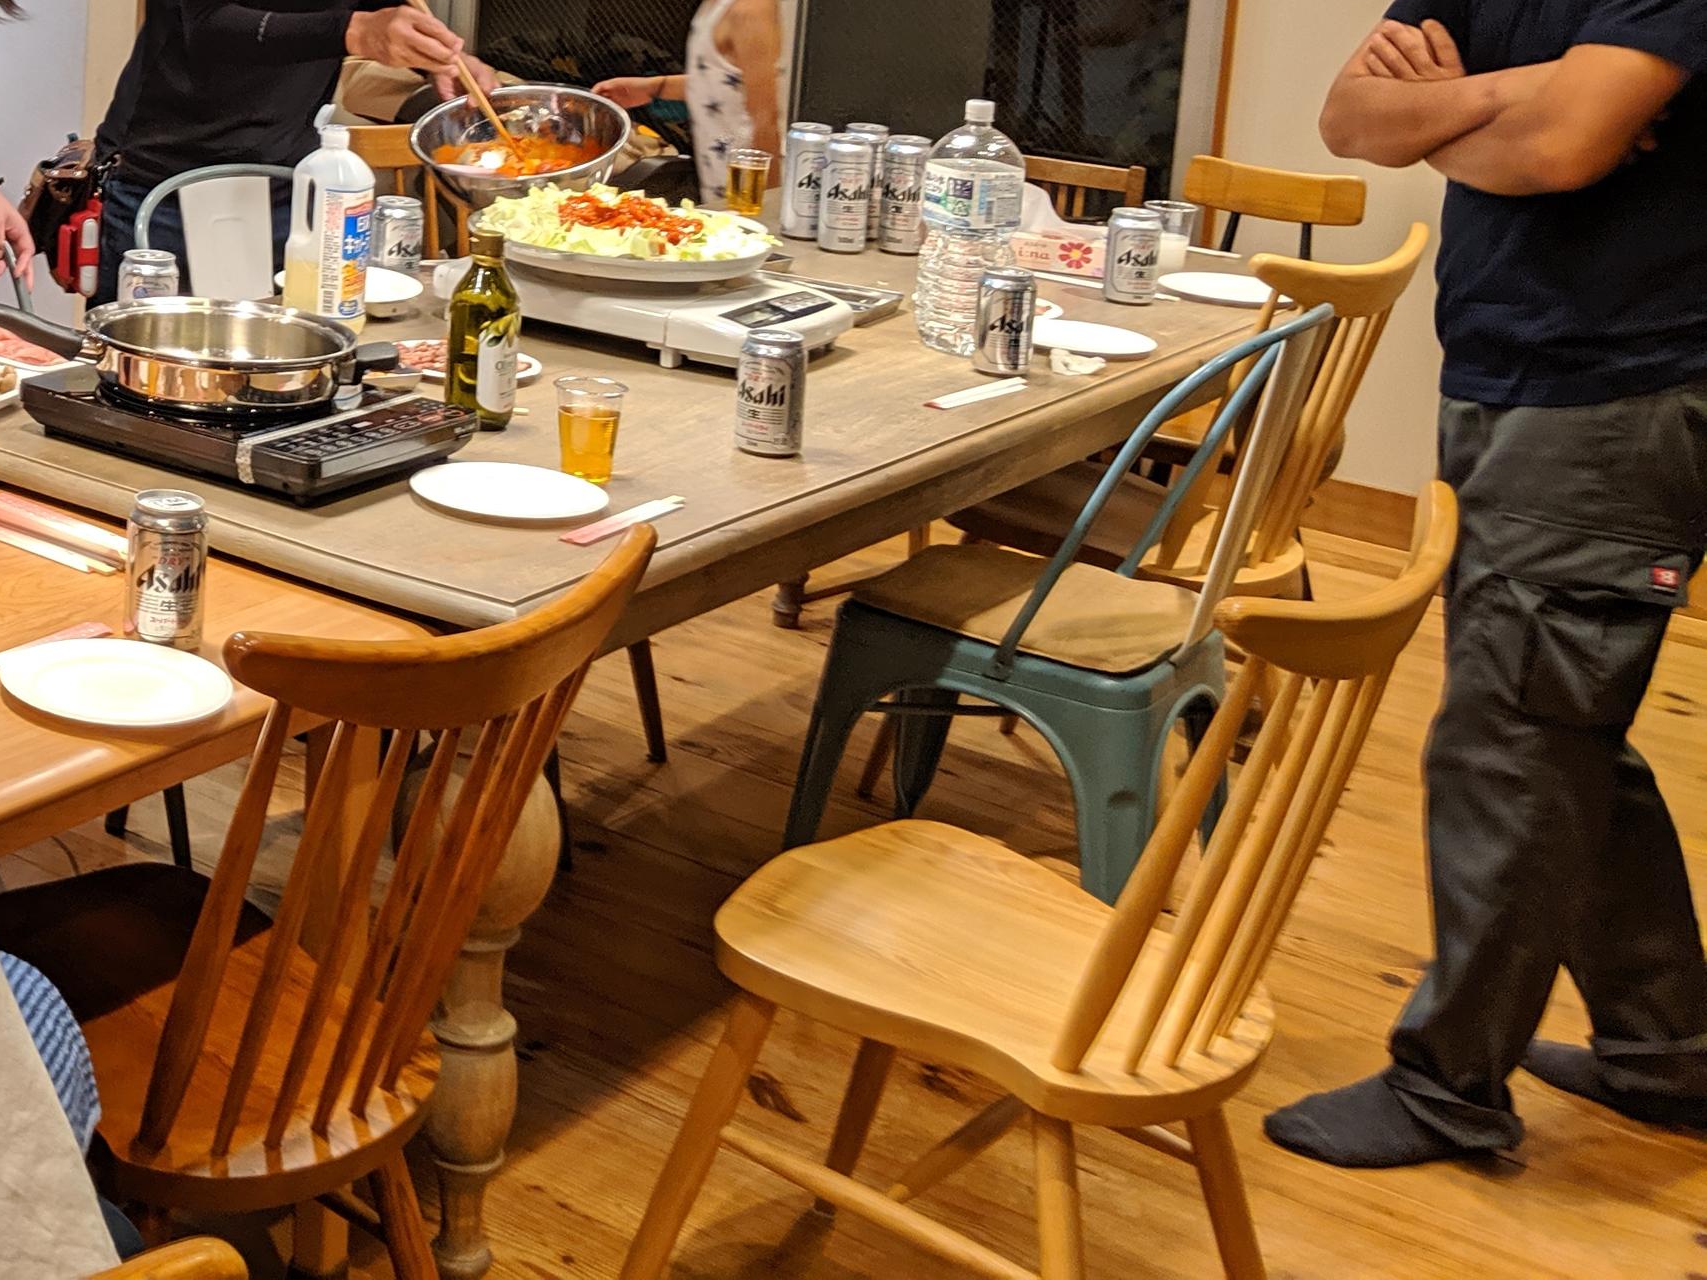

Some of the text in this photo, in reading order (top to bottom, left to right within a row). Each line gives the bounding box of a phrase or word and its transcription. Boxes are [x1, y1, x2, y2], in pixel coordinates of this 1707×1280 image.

[738, 380, 786, 407] Asahi
[136, 563, 201, 593] Asahi
[160, 600, 178, 612] 生
